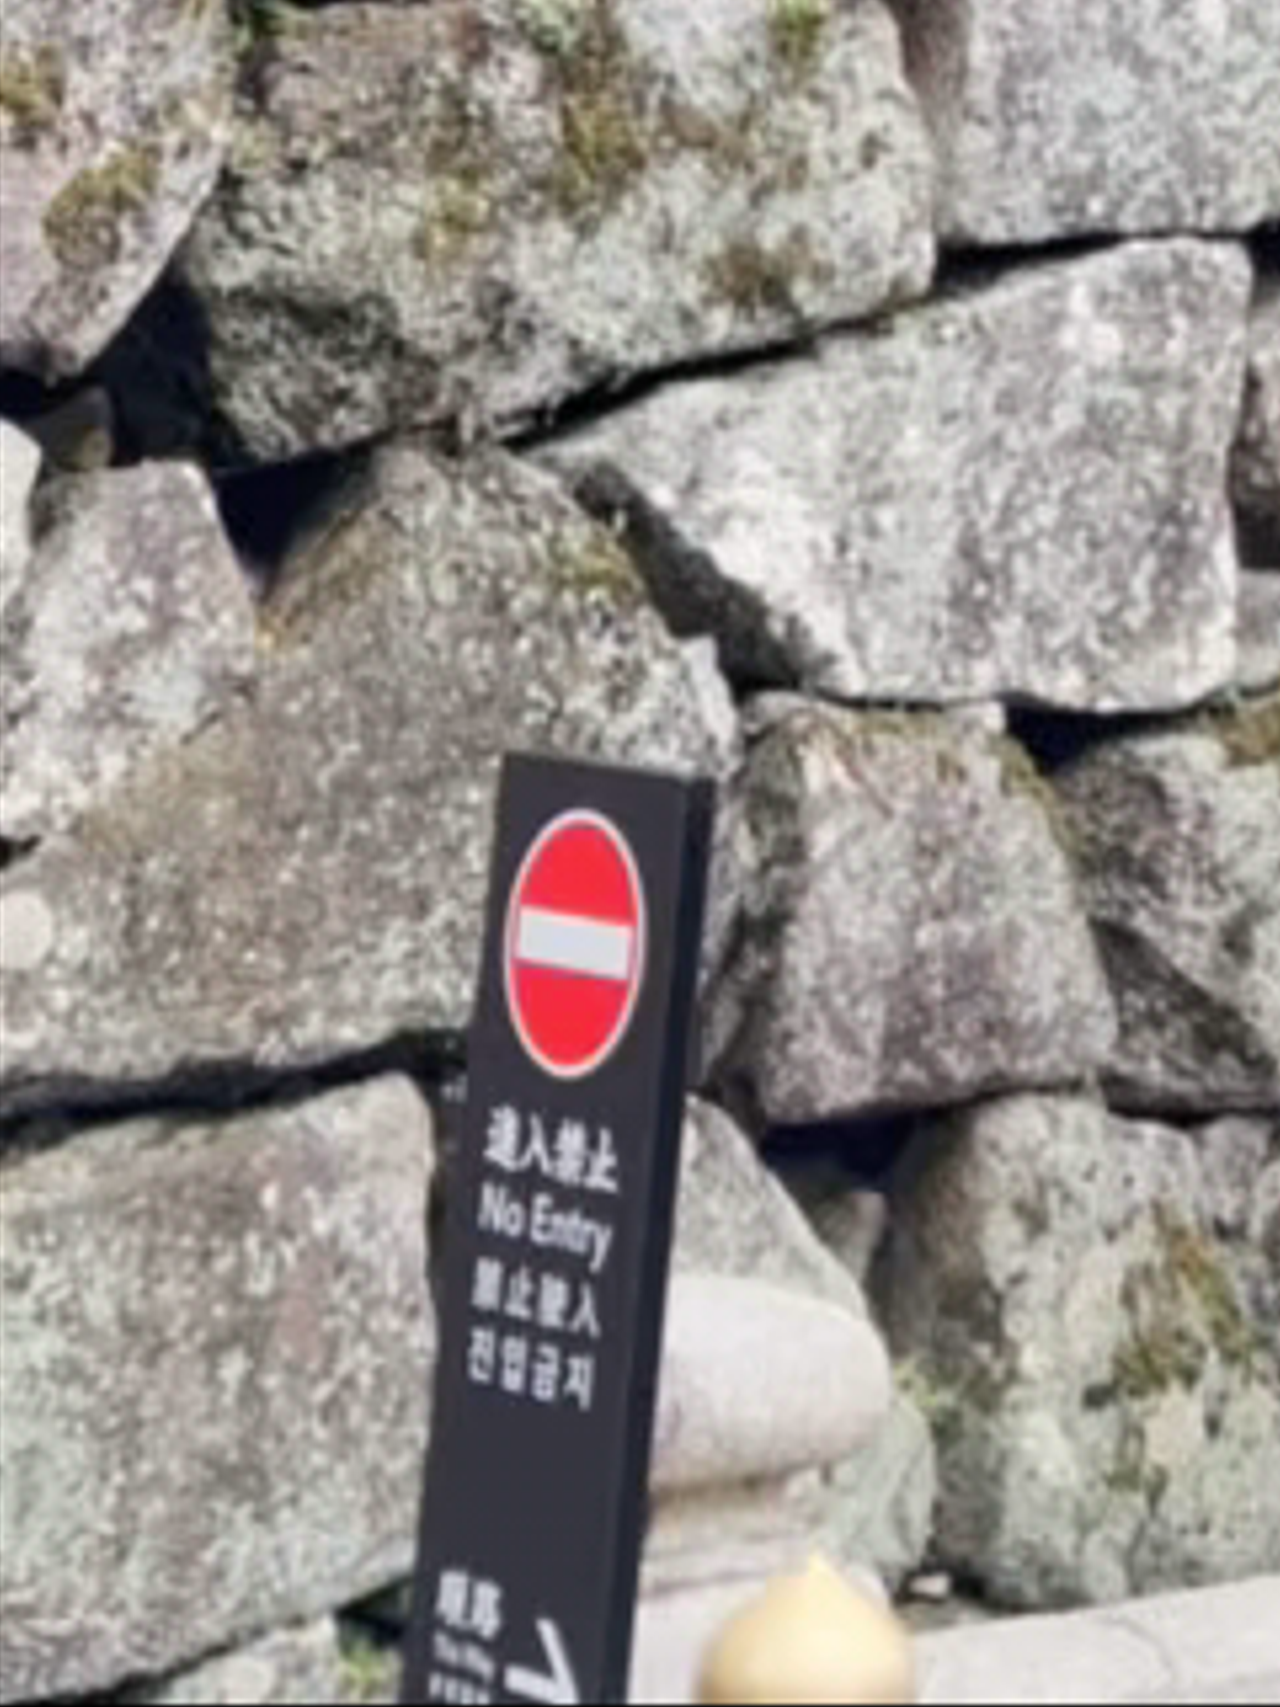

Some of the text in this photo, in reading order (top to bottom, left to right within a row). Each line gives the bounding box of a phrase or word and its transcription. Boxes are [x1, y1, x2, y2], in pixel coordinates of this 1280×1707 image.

[484, 1104, 617, 1194] 進入禁止
[478, 1182, 613, 1274] No Entry
[467, 1327, 595, 1411] 진입금지
